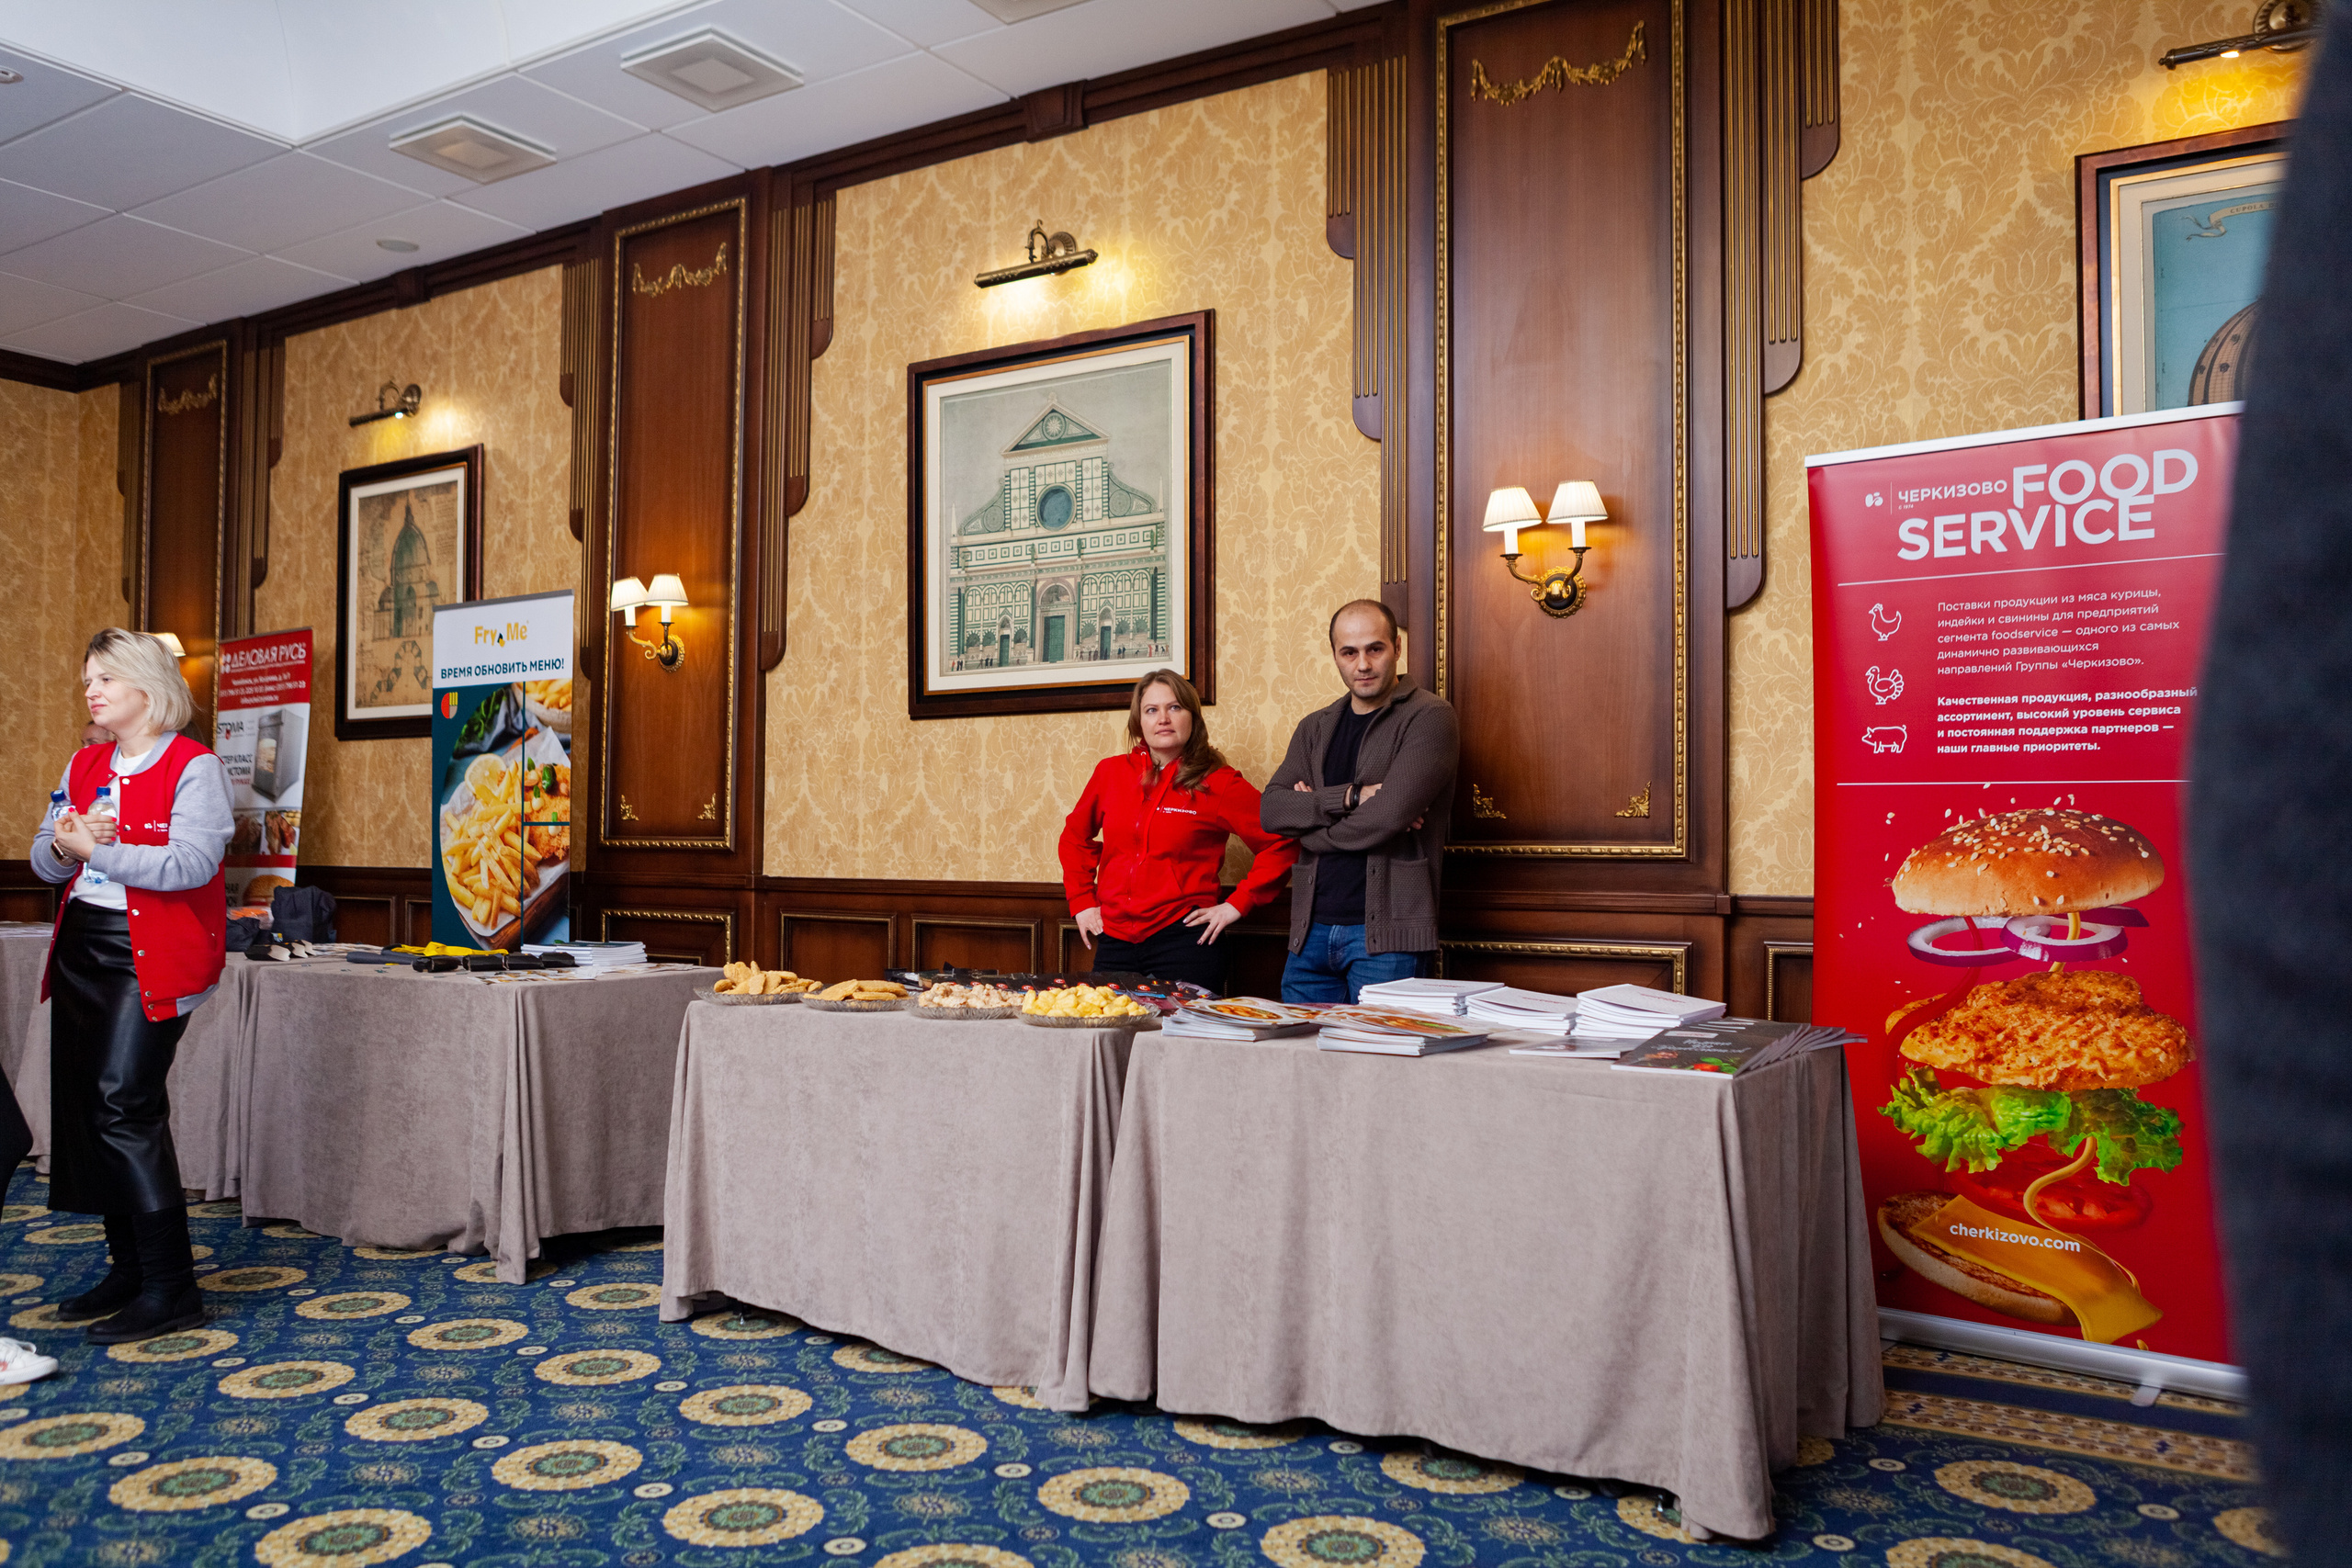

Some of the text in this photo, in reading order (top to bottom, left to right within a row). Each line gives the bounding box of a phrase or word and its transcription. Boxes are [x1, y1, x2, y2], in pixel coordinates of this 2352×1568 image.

[2012, 449, 2199, 509] FOOD
[1898, 479, 2007, 503] ЧЕРКИЗОВО
[1897, 494, 2155, 561] SERVICE
[1938, 589, 2161, 612] Поставки продукции из мяса курицы,
[1938, 604, 2159, 627] индейки и свинины для предприятий
[474, 621, 527, 646] Fry Me
[1938, 633, 1988, 644] сегмента
[1991, 627, 2058, 640] foodservice
[2075, 625, 2119, 637] одного
[2121, 624, 2136, 633] из
[2139, 621, 2180, 632] самых
[231, 646, 277, 669] ДЕЛОВАЯ
[278, 642, 307, 661] РУСЬ
[1937, 642, 2099, 660] динамично развивающихся
[441, 658, 564, 679] ВРЕМЯ ОБНОВИТЬ МЕНЮ!
[1938, 657, 2144, 675] направлений Группы «Черкизово».
[1938, 686, 2198, 706] Качественная продукция, разнообразный
[1937, 705, 2181, 723] ассортимент, высокий уровень сервиса
[1938, 729, 1944, 738] и
[1947, 728, 2015, 738] постоянная
[2018, 726, 2088, 736] поддержка
[2091, 723, 2159, 735] партнеров
[1937, 741, 2101, 753] наши главные приоритеты.
[1950, 1223, 2081, 1253] cherkizovo.com
